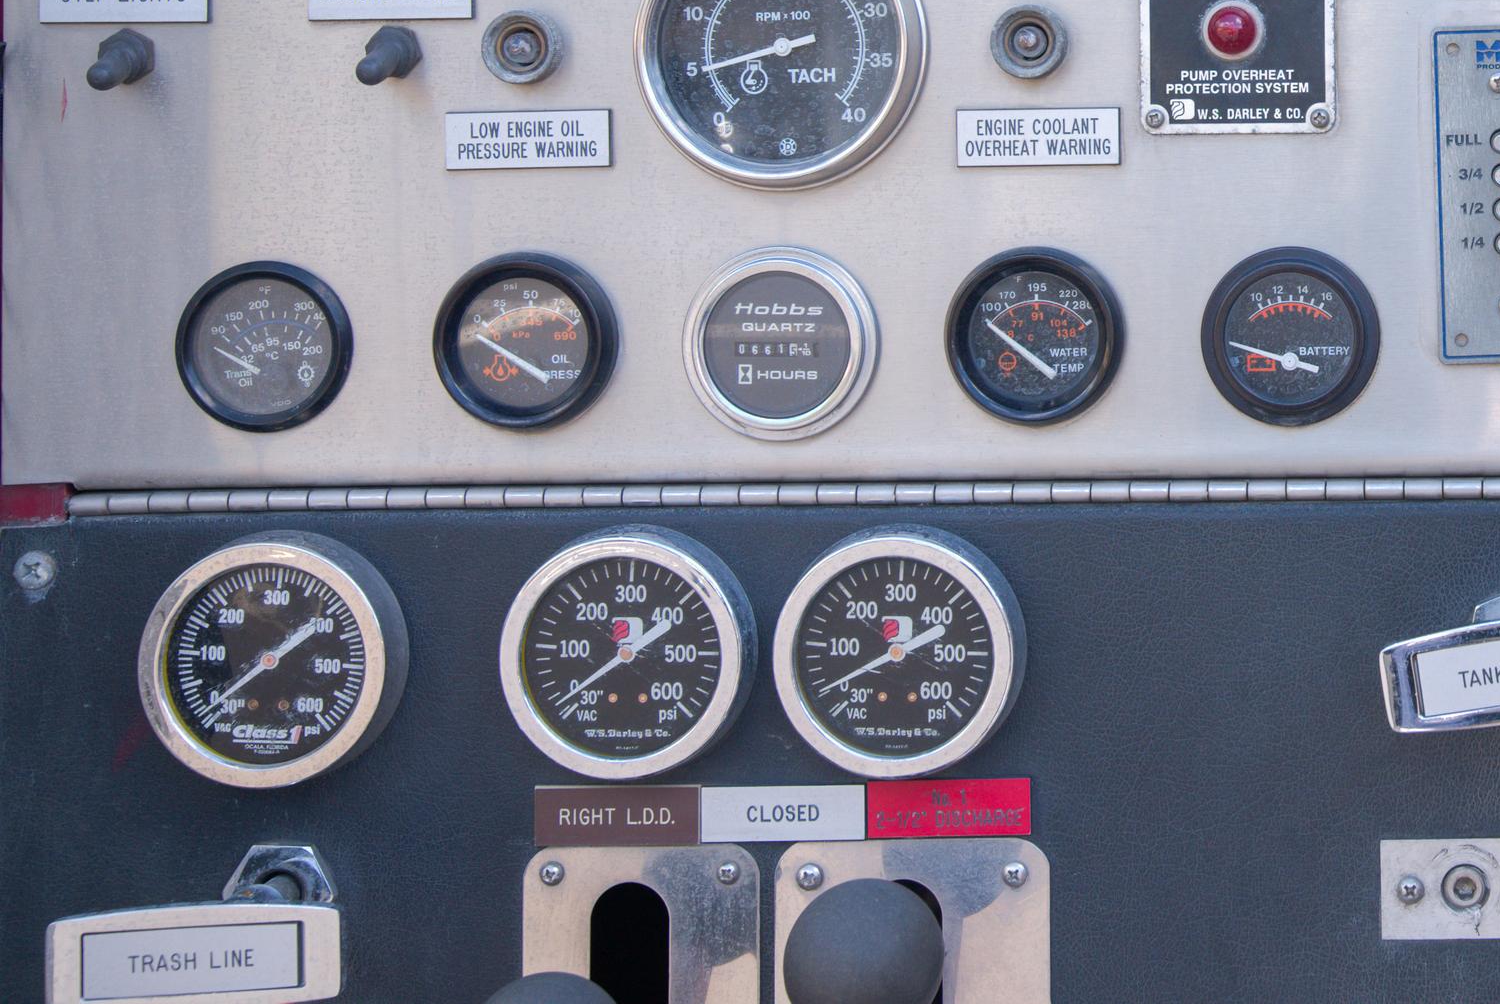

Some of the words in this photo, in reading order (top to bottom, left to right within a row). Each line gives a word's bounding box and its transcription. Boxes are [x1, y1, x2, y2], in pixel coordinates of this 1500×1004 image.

[864, 3, 888, 17] 30
[788, 68, 836, 84] TACH
[1180, 70, 1218, 81] PUMP
[1222, 69, 1294, 81] OVERHEAT
[1166, 82, 1251, 94] PROTECTION
[1255, 82, 1309, 94] SYSTEM
[1198, 108, 1223, 120] W.S.
[1227, 107, 1269, 120] DARLEY
[1273, 108, 1283, 119] &
[1286, 107, 1305, 119] CO.
[469, 122, 500, 138] LOW
[506, 121, 556, 138] ENGINE
[560, 120, 584, 137] OIL
[976, 119, 1024, 136] ENGINE
[1032, 118, 1099, 135] COOLANT
[1445, 134, 1482, 146] FULL
[457, 142, 528, 160] PRESSURE
[534, 140, 597, 158] WARNING
[965, 140, 1038, 157] OVERHEAT
[1047, 139, 1111, 156] WARNING
[1458, 169, 1483, 180] 3/4
[1460, 203, 1484, 215] 1/2
[1461, 237, 1485, 249] 1/4
[734, 303, 823, 316] Hobbs
[742, 322, 816, 332] QUARTZ
[1049, 347, 1088, 357] WATER
[1299, 345, 1350, 356] BATTERY
[757, 370, 818, 380] HOURS
[264, 590, 290, 606] 300
[934, 645, 965, 662] 500
[651, 682, 682, 700] 600
[558, 808, 615, 826] RIGHT
[626, 807, 676, 825] L.D.D.
[746, 805, 821, 822] CLOSED
[128, 953, 197, 974] TRASH
[210, 949, 255, 969] LINE
